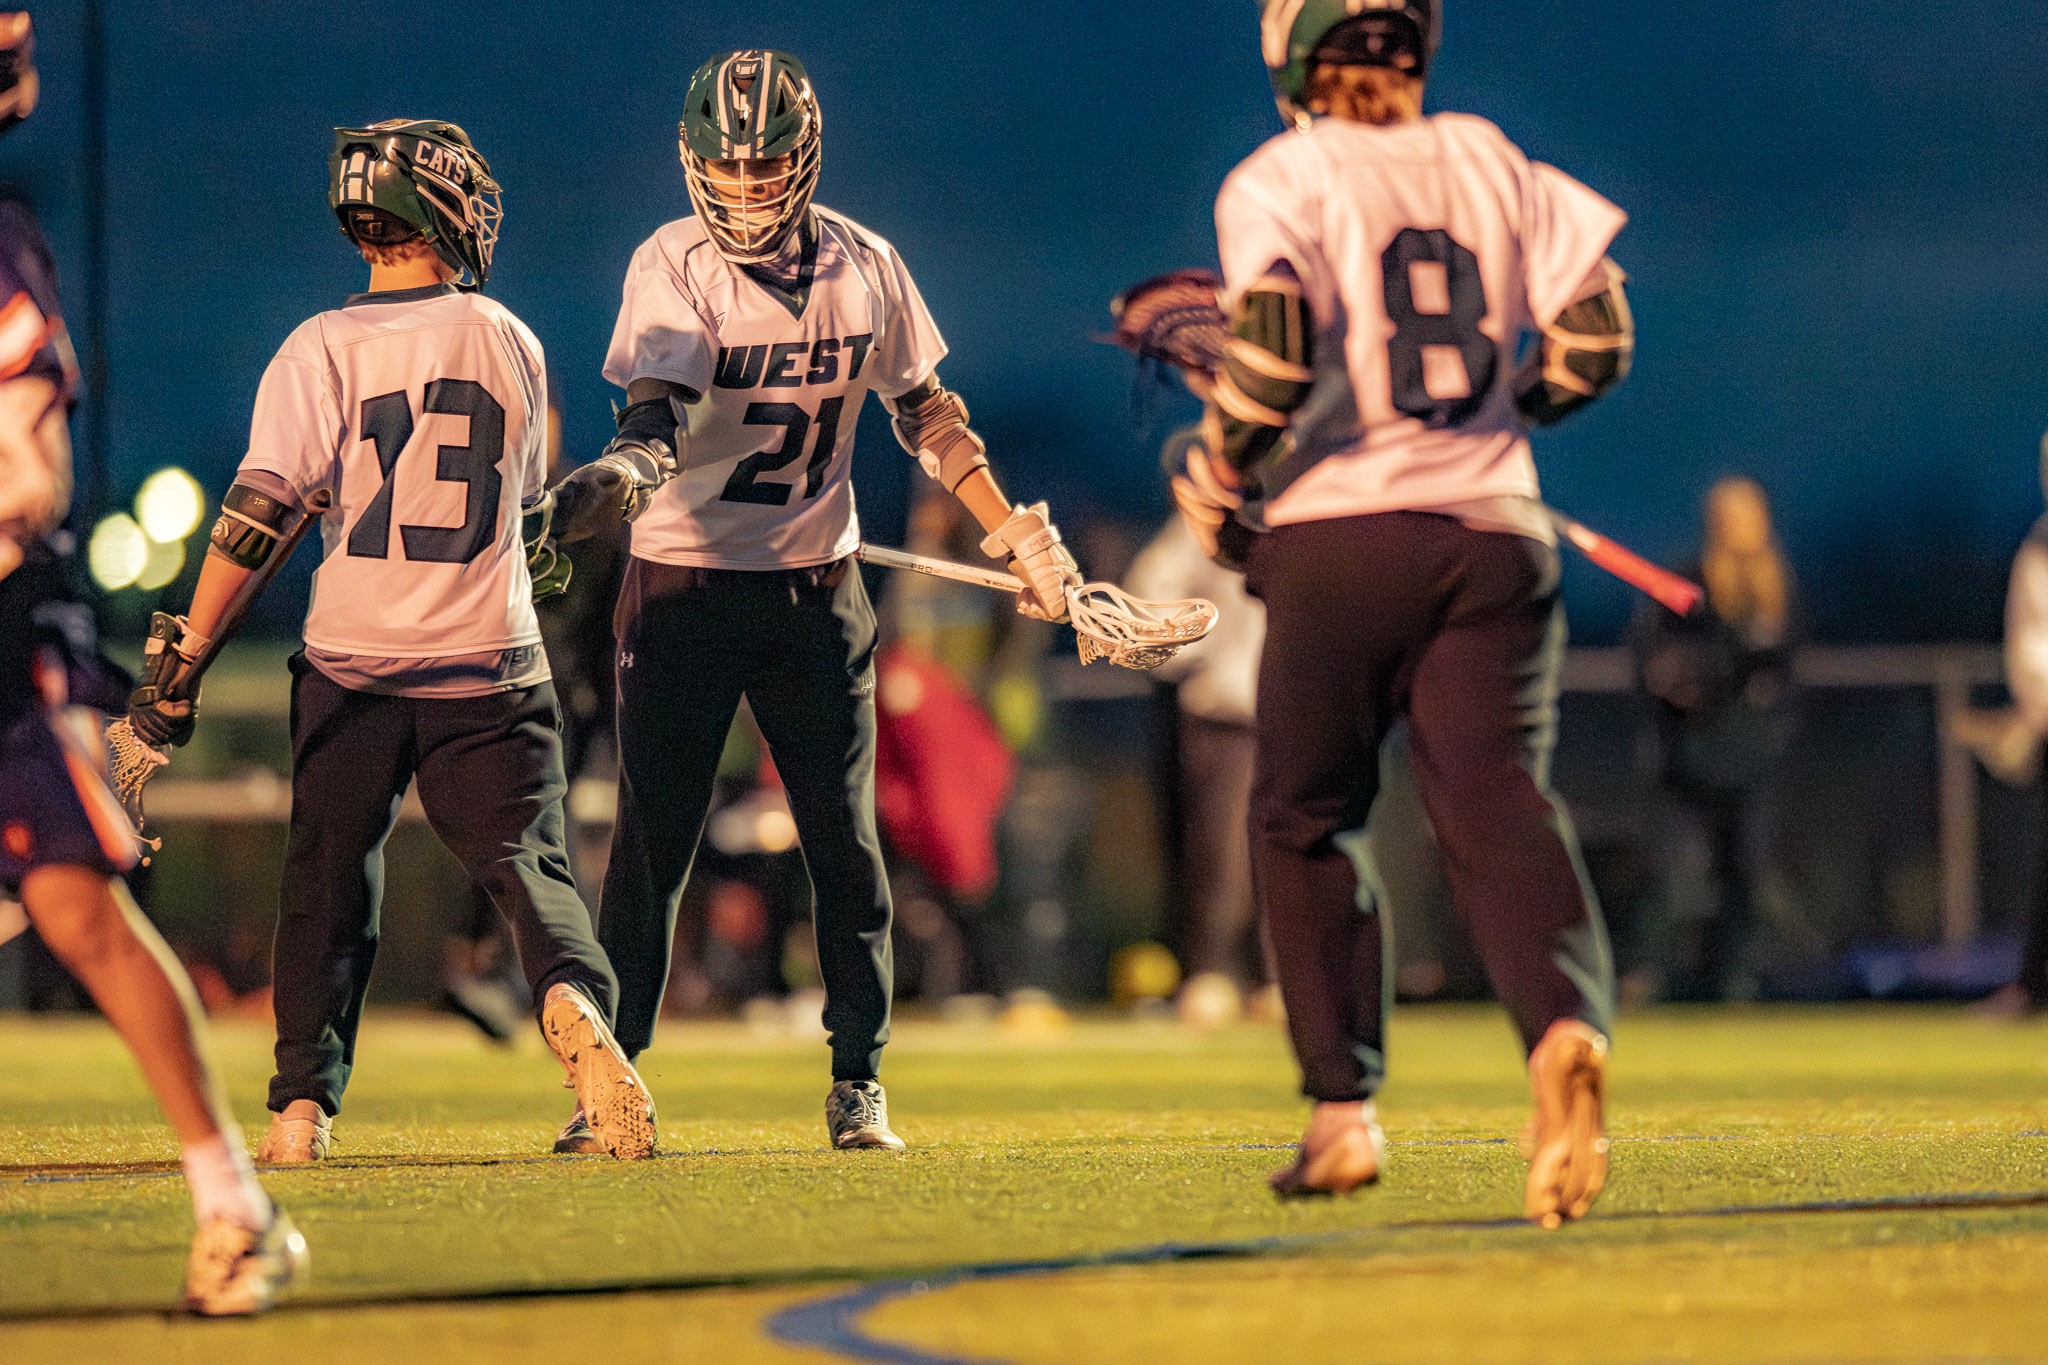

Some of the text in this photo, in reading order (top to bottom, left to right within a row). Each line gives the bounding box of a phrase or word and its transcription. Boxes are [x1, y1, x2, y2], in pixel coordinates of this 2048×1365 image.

[414, 140, 467, 184] CATS
[713, 333, 873, 389] WEST
[1381, 228, 1496, 430] 8
[347, 378, 505, 564] 13
[719, 396, 844, 506] 21
